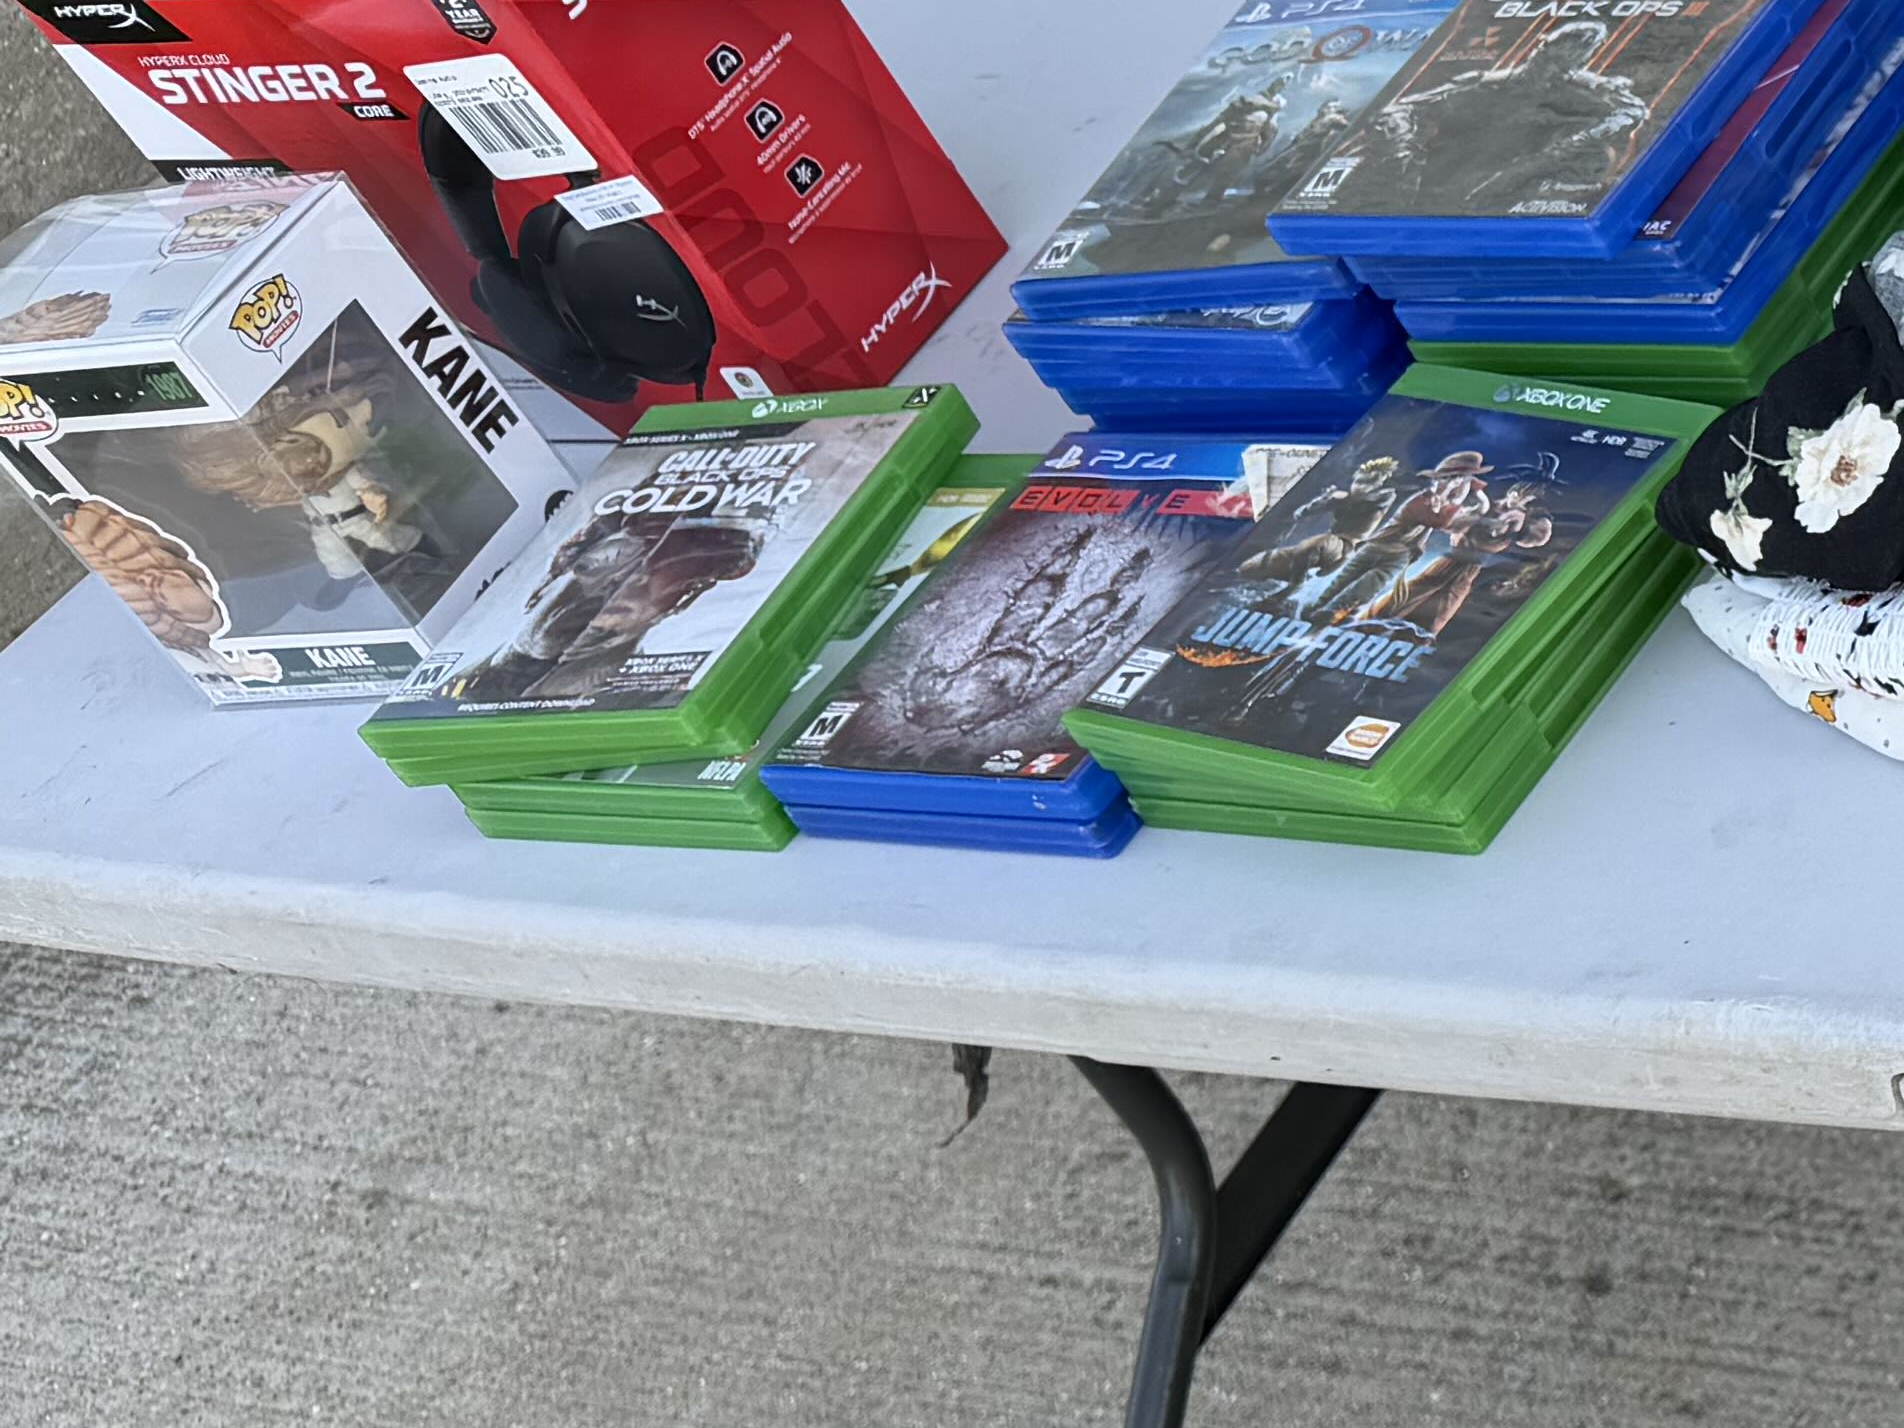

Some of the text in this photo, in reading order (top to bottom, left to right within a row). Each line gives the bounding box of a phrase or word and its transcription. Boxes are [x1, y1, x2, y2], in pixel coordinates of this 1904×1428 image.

[445, 8, 481, 22] YEAR
[1494, 1, 1610, 19] BLACK
[1611, 1, 1684, 18] OPS
[137, 52, 231, 68] HYPERX CLOUD
[148, 61, 387, 104] STINGER 2
[488, 76, 529, 99] 025
[353, 104, 395, 119] CORE
[229, 273, 297, 345] POP!
[398, 306, 520, 454] KANE
[1516, 387, 1610, 414] XBOX ONE
[658, 448, 727, 473] CALL
[733, 442, 816, 467] DUTY
[1088, 450, 1179, 470] PS4
[653, 465, 792, 486] BLACK OPS
[593, 478, 813, 515] COLD WAR
[1018, 488, 1192, 510] EVOLVE
[1191, 608, 1437, 683] JUMP FORCE
[304, 646, 376, 669] KANE
